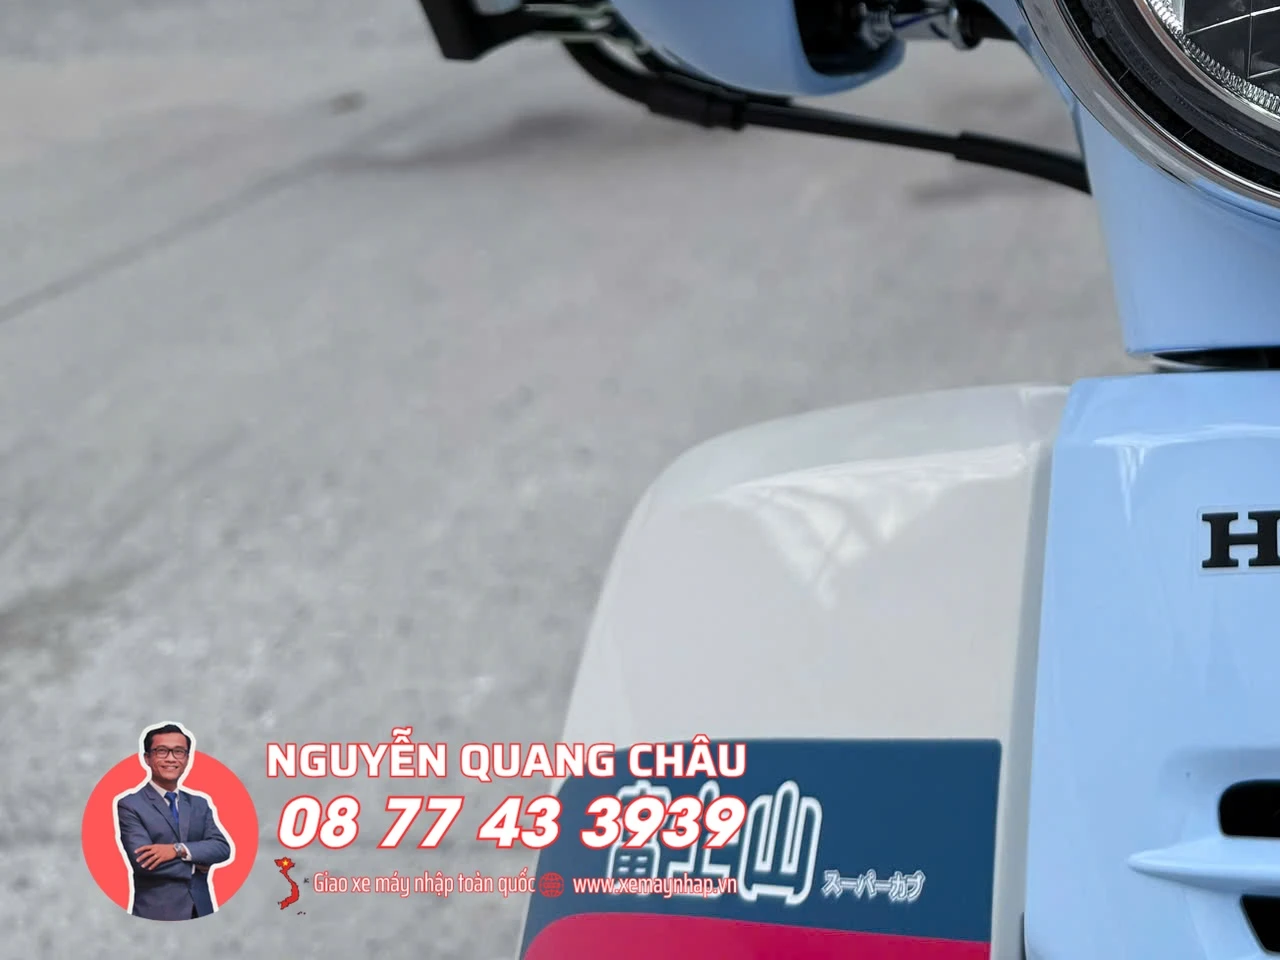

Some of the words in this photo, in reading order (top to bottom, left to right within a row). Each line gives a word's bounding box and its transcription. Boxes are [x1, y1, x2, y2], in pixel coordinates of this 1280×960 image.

[820, 868, 926, 902] スーパーカブ
